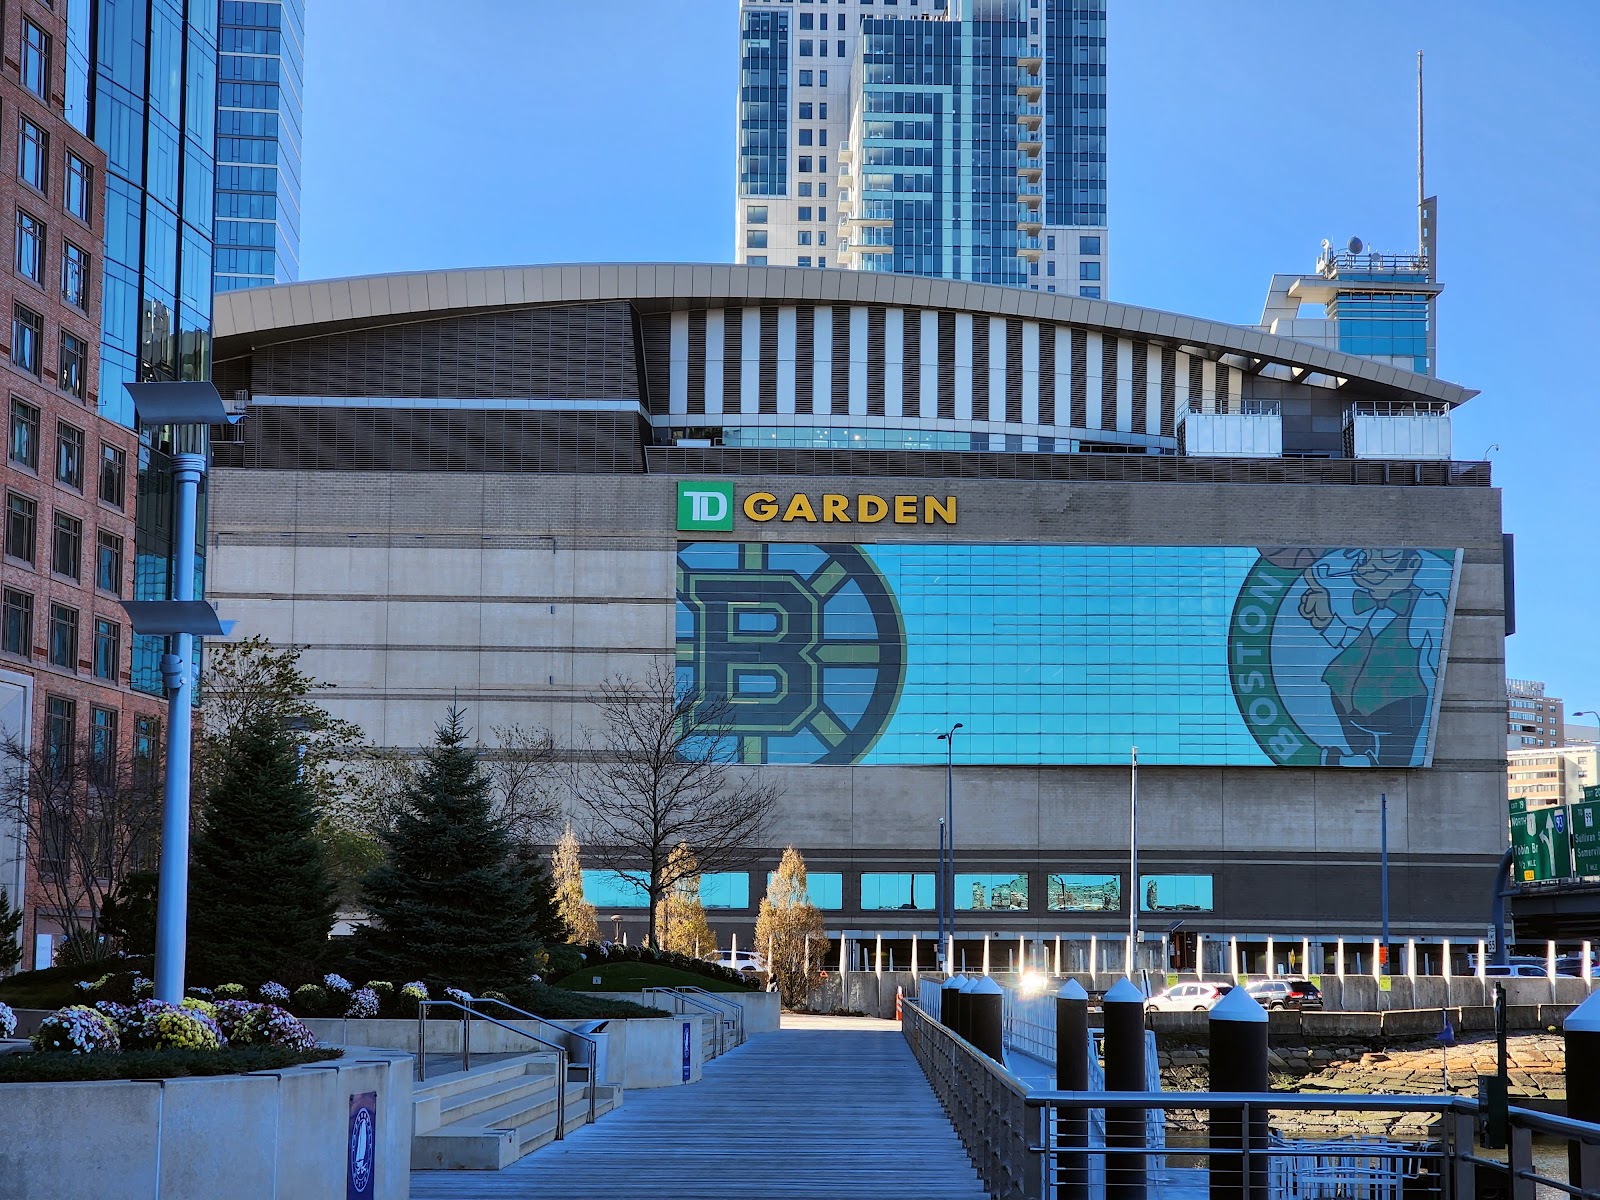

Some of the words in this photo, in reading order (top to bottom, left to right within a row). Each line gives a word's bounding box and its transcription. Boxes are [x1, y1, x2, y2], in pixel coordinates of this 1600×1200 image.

[683, 491, 728, 521] TD
[743, 491, 957, 524] GARDEN
[1236, 570, 1304, 762] BOSTON
[1511, 816, 1527, 827] NORTH
[1556, 816, 1564, 828] 93
[1575, 833, 1596, 843] Sullivan
[1513, 844, 1530, 855] Tobin
[1531, 842, 1539, 854] Br
[1527, 859, 1537, 867] MILE
